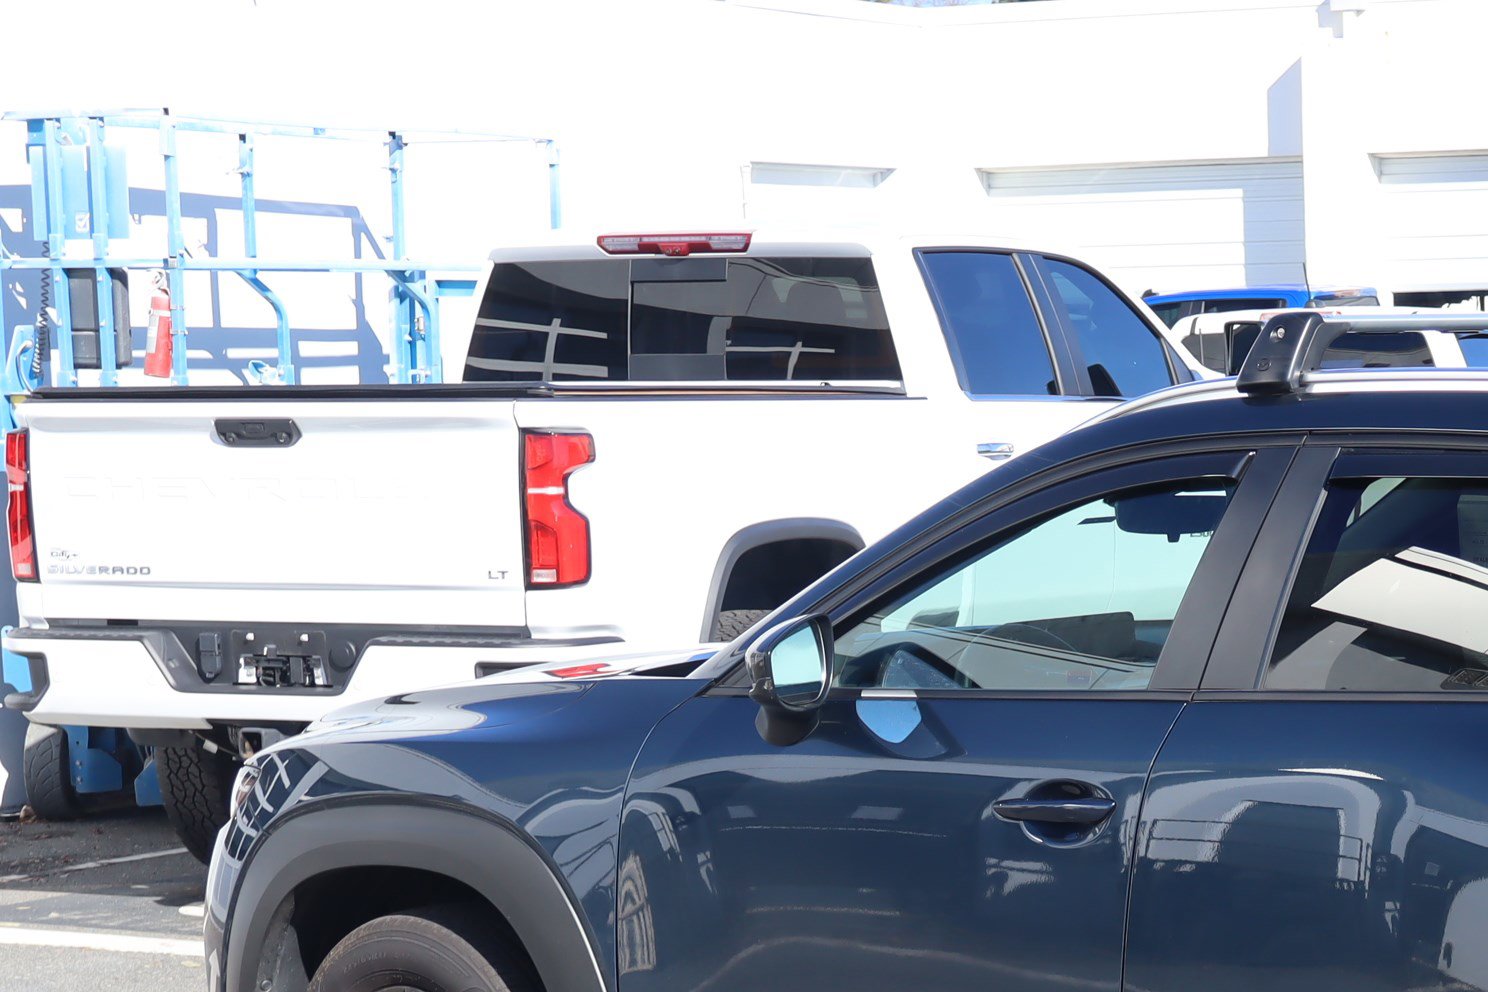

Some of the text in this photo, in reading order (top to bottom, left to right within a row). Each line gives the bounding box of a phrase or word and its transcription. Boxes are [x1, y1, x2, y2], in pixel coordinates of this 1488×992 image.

[62, 475, 427, 502] CHEVROL
[47, 564, 151, 576] SILVERADO
[488, 570, 509, 580] LT
